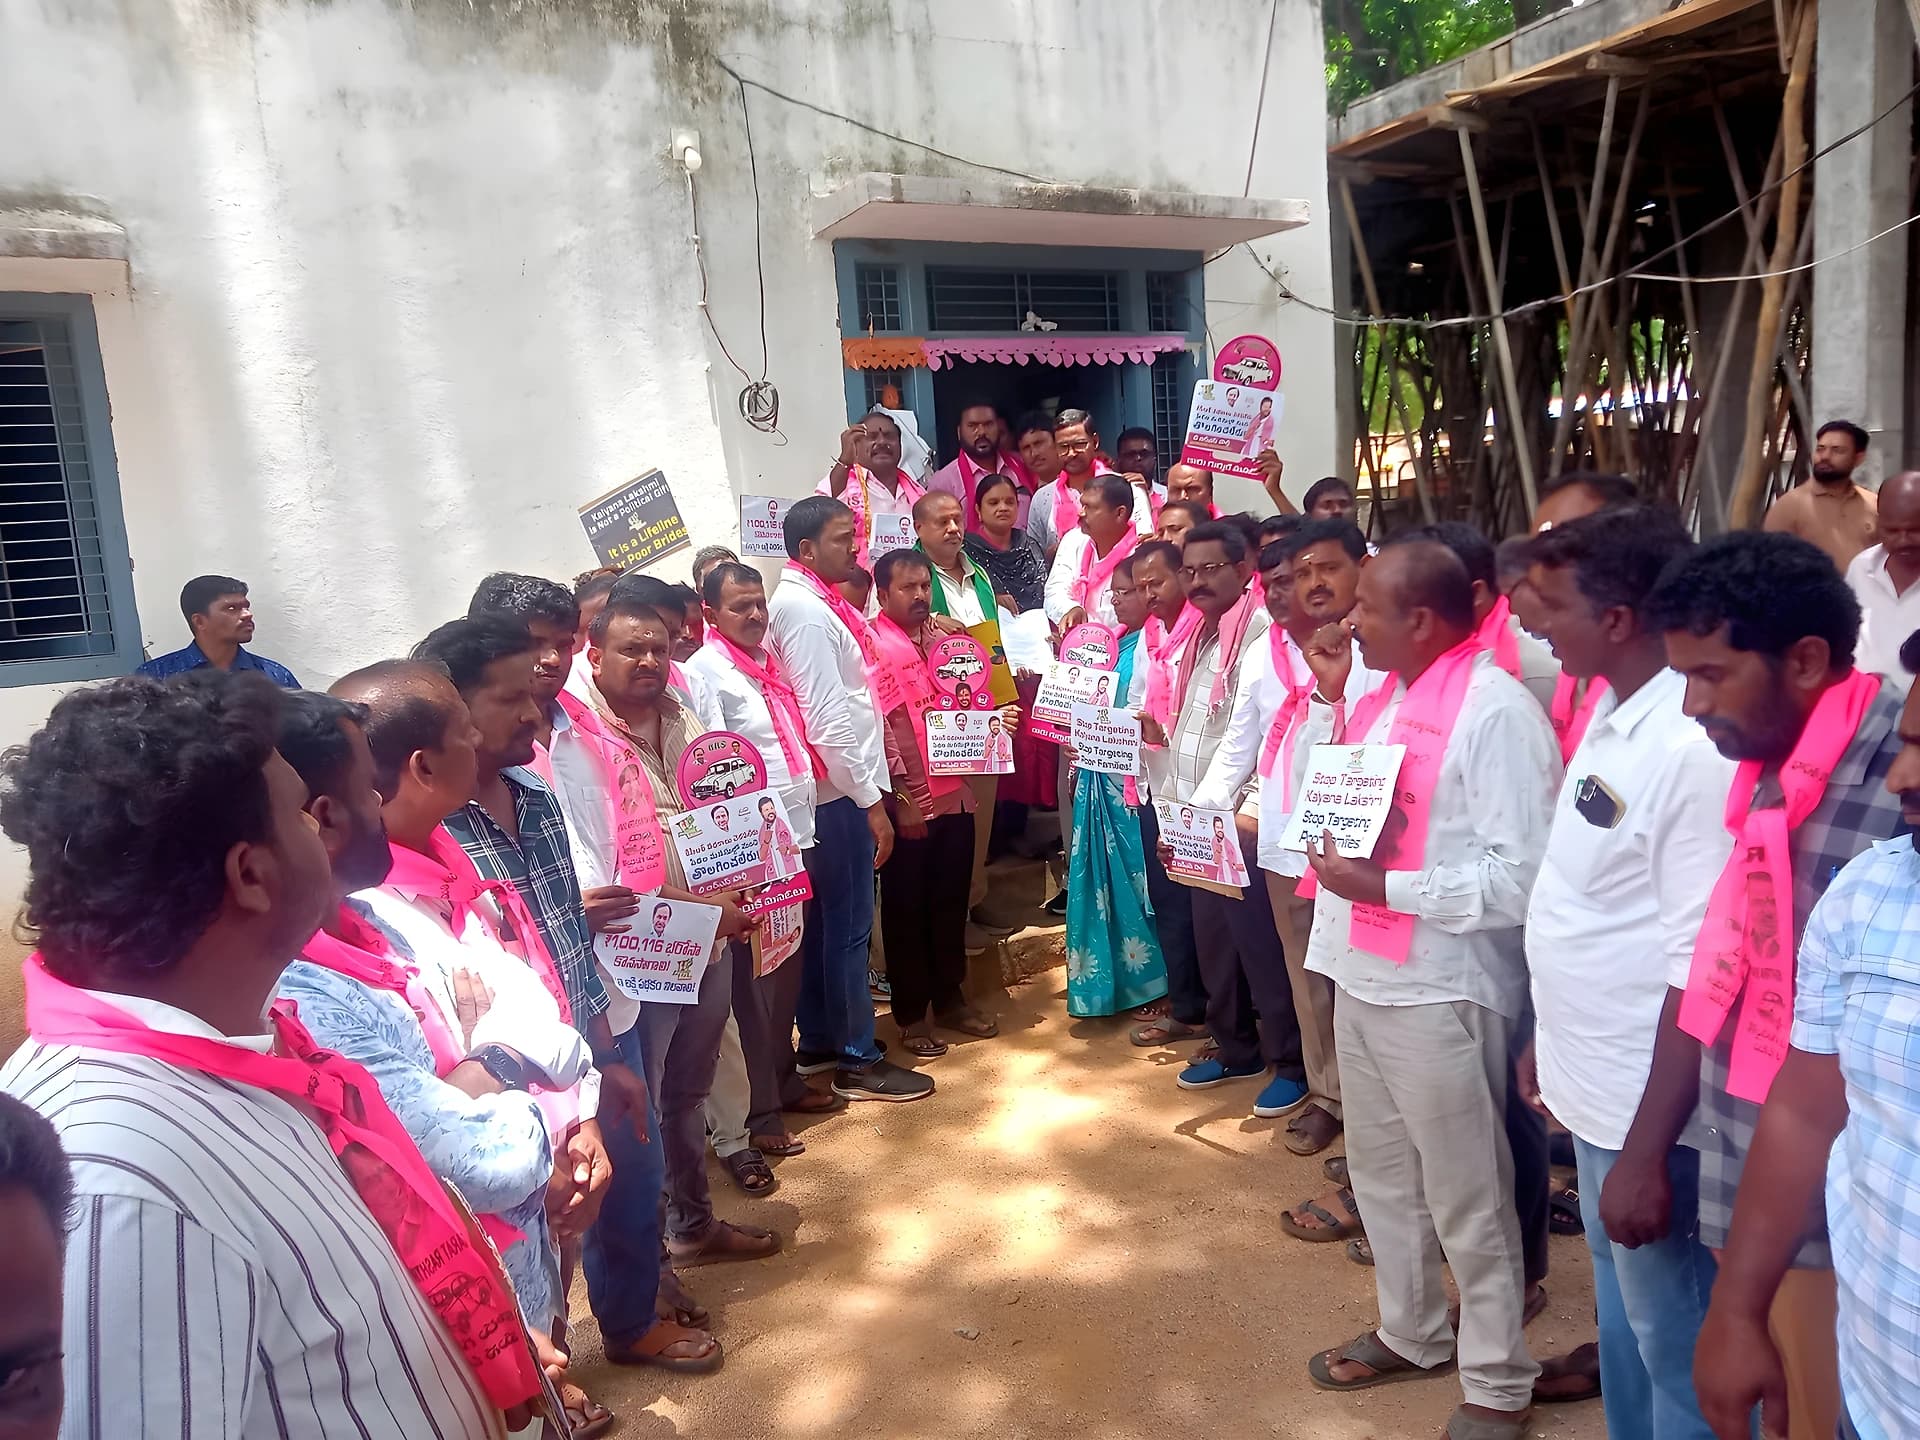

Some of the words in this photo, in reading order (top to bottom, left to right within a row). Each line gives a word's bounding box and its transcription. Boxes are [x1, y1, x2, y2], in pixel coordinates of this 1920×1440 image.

[590, 499, 624, 522] Kalyana
[624, 478, 660, 503] Lakshmi
[588, 526, 597, 535] Is
[597, 516, 612, 530] Not
[619, 495, 654, 517] Political
[608, 548, 618, 559] It
[618, 542, 629, 554] is
[630, 538, 638, 547] a
[638, 515, 679, 542] Lifeline
[627, 545, 652, 564] Poor
[653, 527, 689, 549] Brides
[1074, 728, 1101, 743] Kalyana
[1102, 735, 1138, 747] Lakshmi
[1076, 718, 1093, 731] Stop
[1093, 722, 1135, 738] Targeting
[1078, 742, 1093, 755] Stop
[1094, 746, 1133, 761] Targeting
[1097, 759, 1132, 771] Families!
[1312, 772, 1337, 788] Stop
[1340, 773, 1387, 791] Targeting
[1305, 789, 1342, 806] Kalyana
[1344, 792, 1383, 806] Lakshmi
[1302, 810, 1325, 828] Stop
[1327, 812, 1372, 832] Targeting
[604, 934, 663, 953] ₹1,00,116
[665, 940, 702, 957] భరోసా
